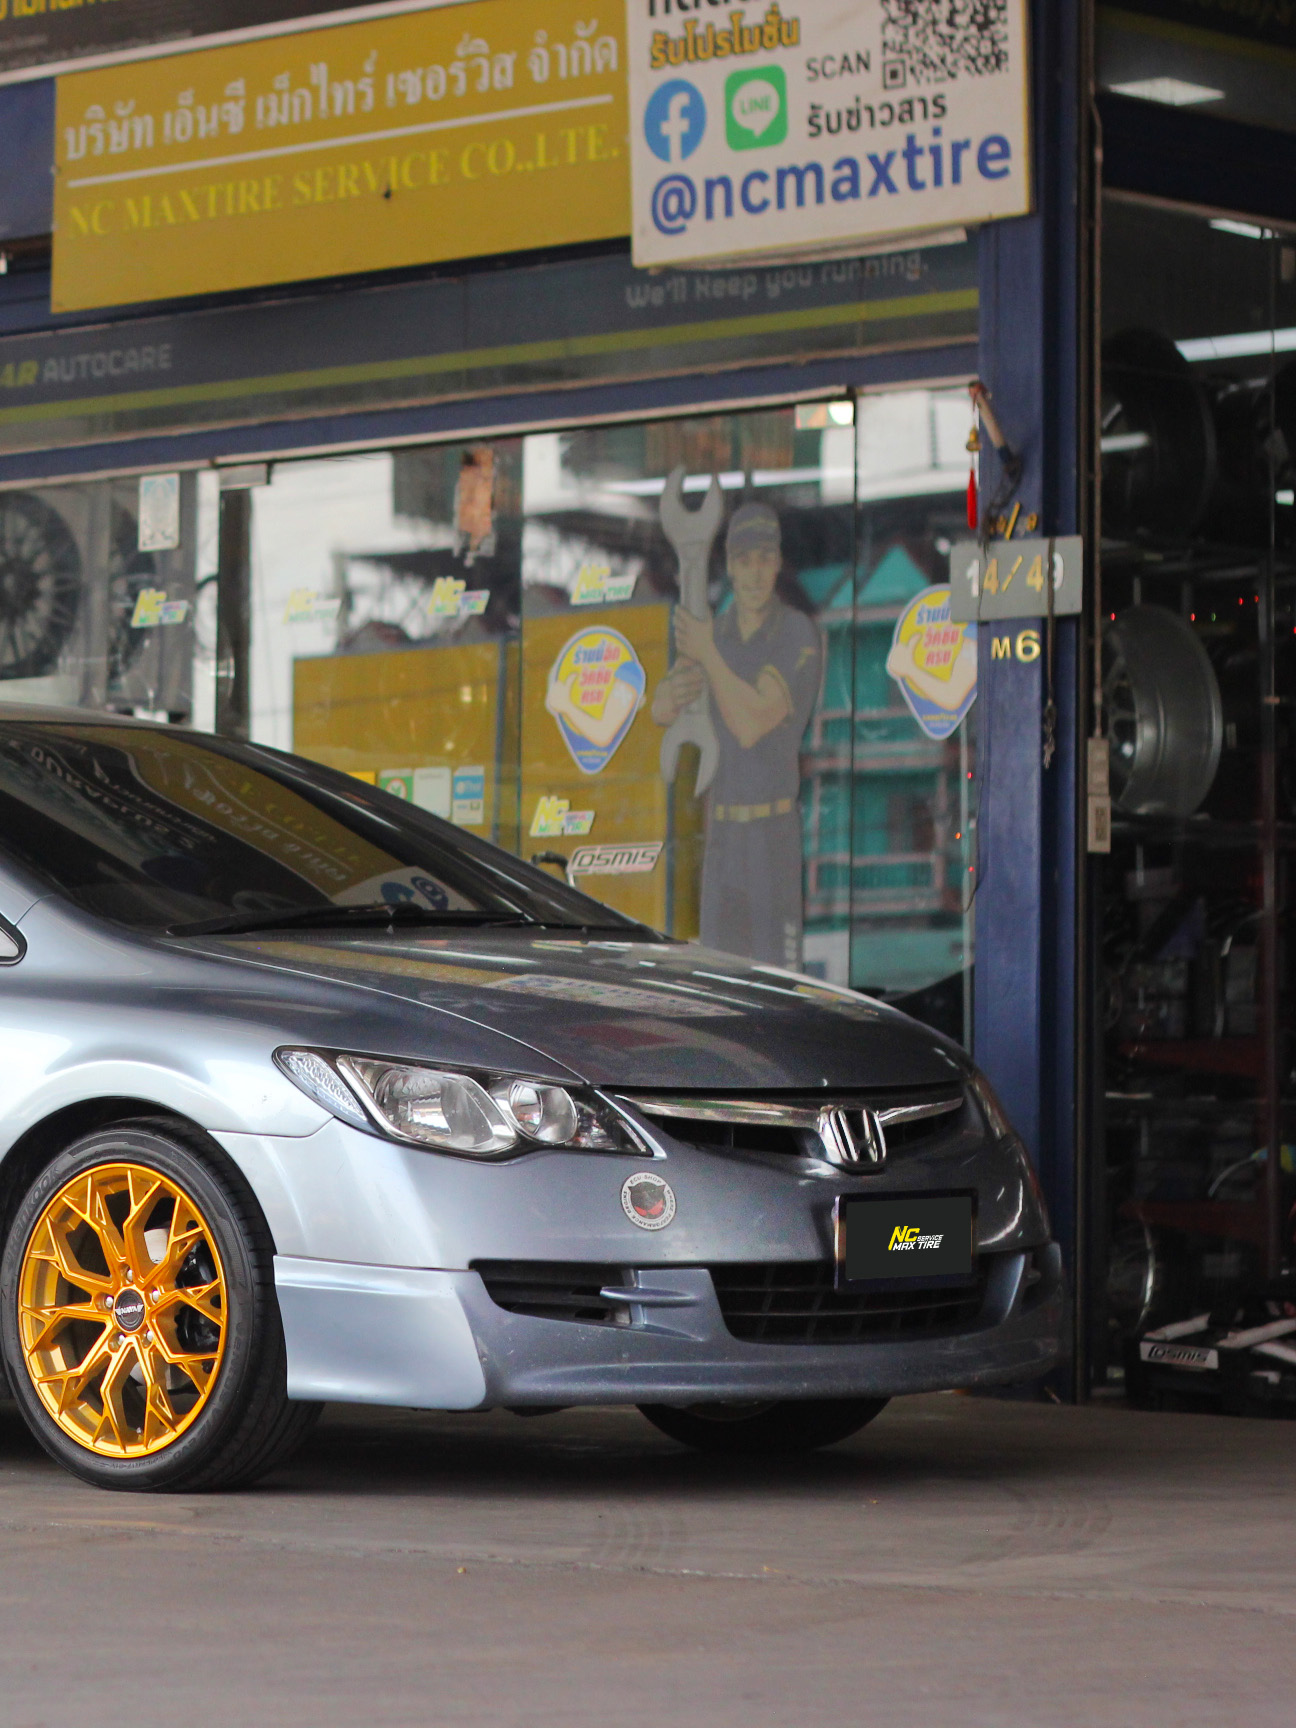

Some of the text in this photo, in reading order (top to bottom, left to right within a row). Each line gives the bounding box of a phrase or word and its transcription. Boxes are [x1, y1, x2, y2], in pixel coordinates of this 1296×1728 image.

[650, 2, 800, 70] รับโปรโมชั่น
[806, 50, 871, 82] SCAN
[65, 98, 154, 161] บริษัท
[163, 78, 246, 145] เอ็นซี
[386, 32, 517, 108] เซอร์วิส
[528, 18, 619, 84] จำกัด
[739, 94, 772, 116] LINE
[808, 94, 947, 138] รับข่าวสาร
[67, 202, 114, 240] NC
[125, 176, 284, 230] MAXTIRE
[293, 149, 452, 204] SERVICE
[651, 126, 1012, 236] @ncmaxtire
[42, 343, 172, 384] AUTOCARE
[966, 552, 1064, 598] 14/49
